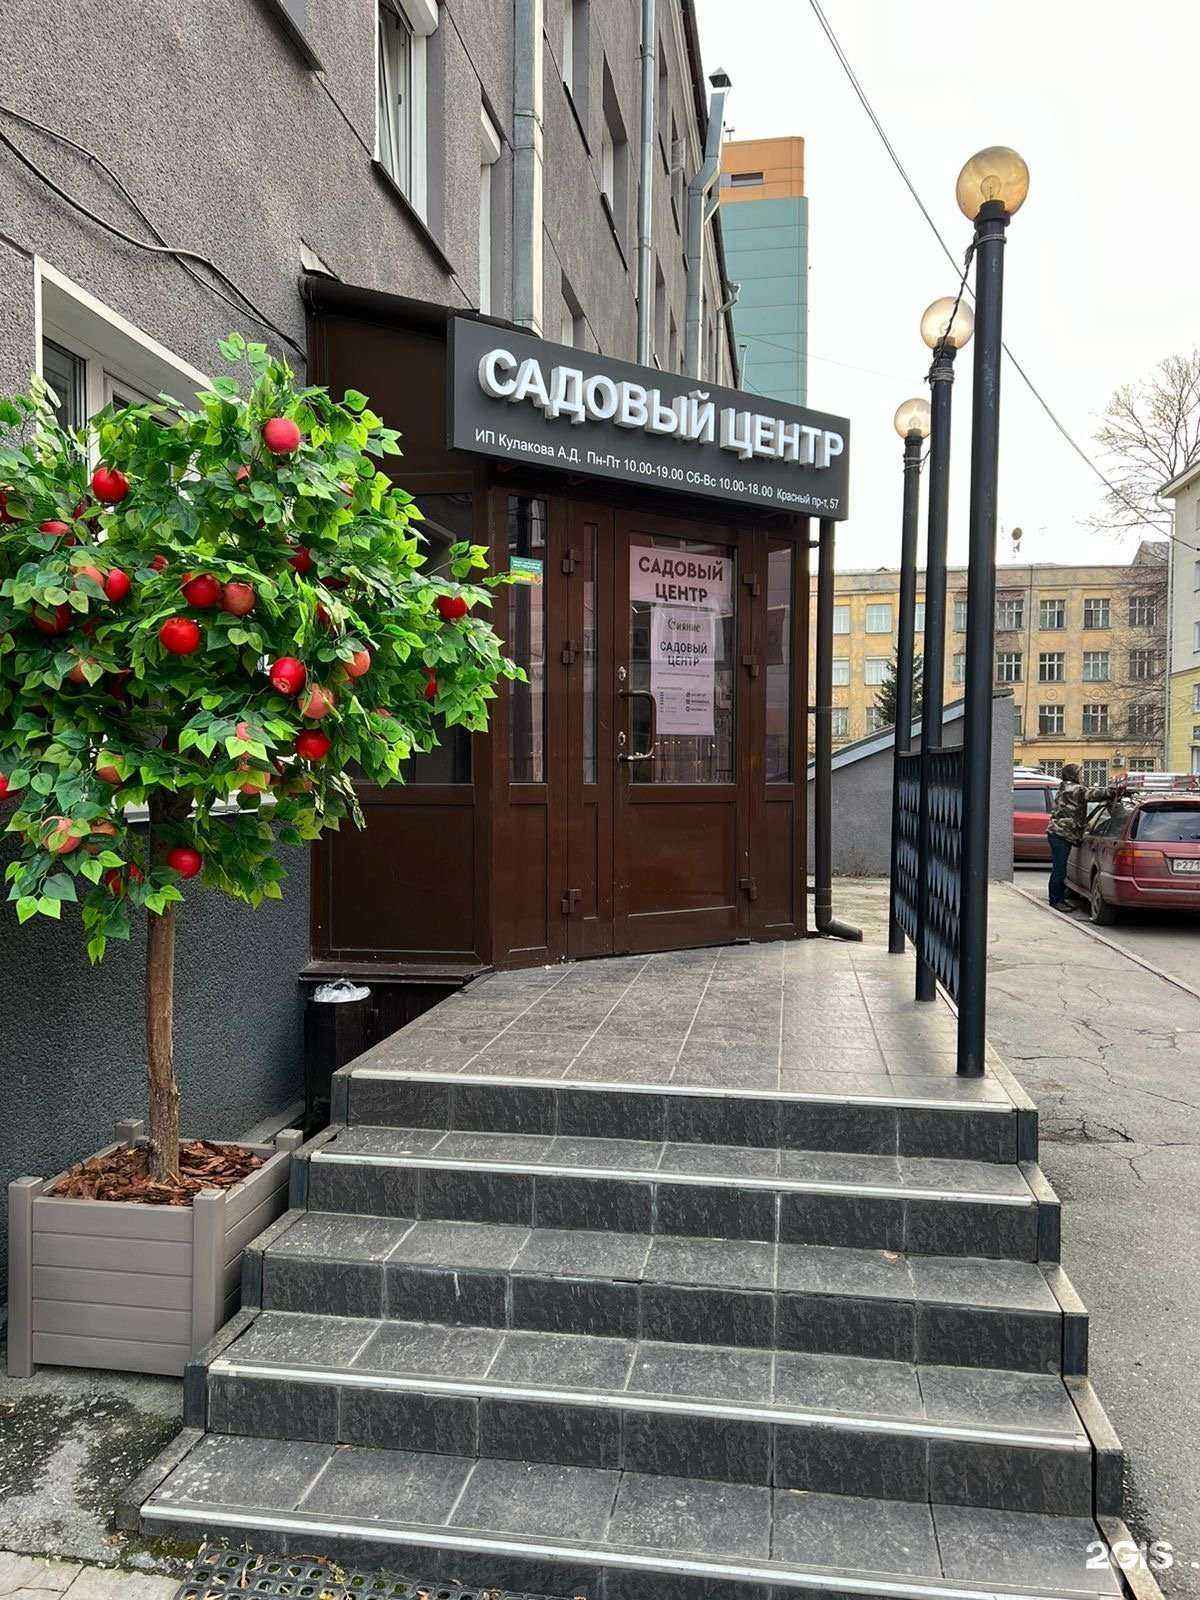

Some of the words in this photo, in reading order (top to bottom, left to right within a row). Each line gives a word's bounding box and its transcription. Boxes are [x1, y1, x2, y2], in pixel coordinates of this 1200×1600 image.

[478, 348, 717, 443] САДОВЫЙ
[720, 406, 845, 470] ЦЕНТР
[475, 428, 495, 445] ИП
[499, 433, 555, 458] Кулакова
[557, 446, 582, 464] А.Д.
[587, 451, 621, 469] Пн-Пт
[624, 458, 684, 482] 10.00-19.00
[686, 470, 717, 487] Сб-Вс
[719, 477, 773, 499] 10.00-18.00
[776, 487, 811, 505] Красный
[638, 556, 723, 582] САДОВЫЙ
[655, 583, 708, 603] ЦЕНТР
[660, 641, 708, 655] САДОВЫЙ
[668, 655, 700, 667] ЦЕНТР
